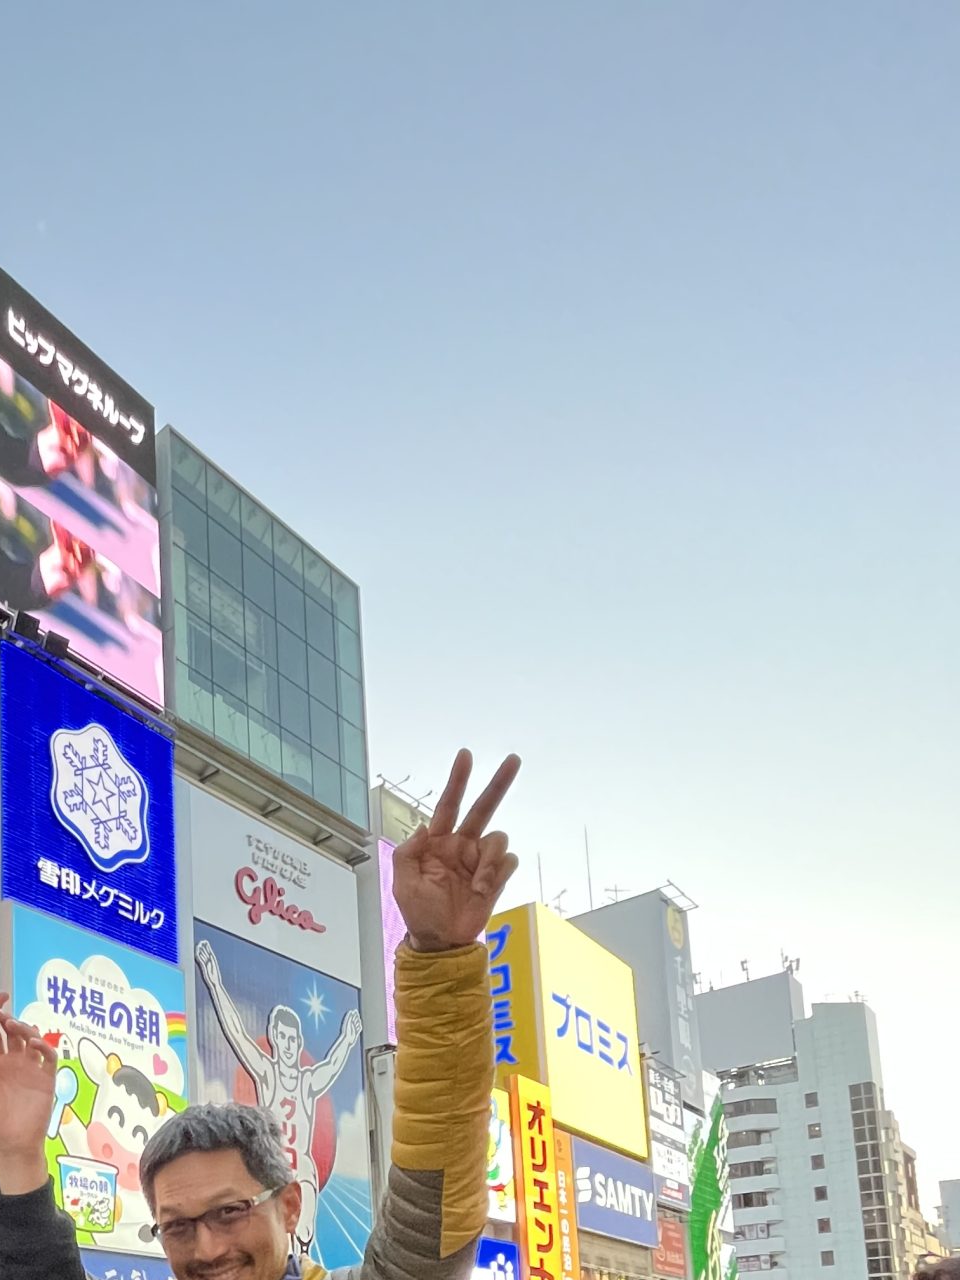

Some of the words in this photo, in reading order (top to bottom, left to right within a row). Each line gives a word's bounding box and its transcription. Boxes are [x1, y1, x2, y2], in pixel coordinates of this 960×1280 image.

[8, 307, 146, 446] ピップマグネループ
[36, 857, 165, 930] 雪印メグミルク
[234, 866, 327, 933] Glico
[47, 976, 160, 1047] 牧場の朝
[552, 992, 633, 1077] プロミス
[594, 1171, 654, 1222] SAMTY
